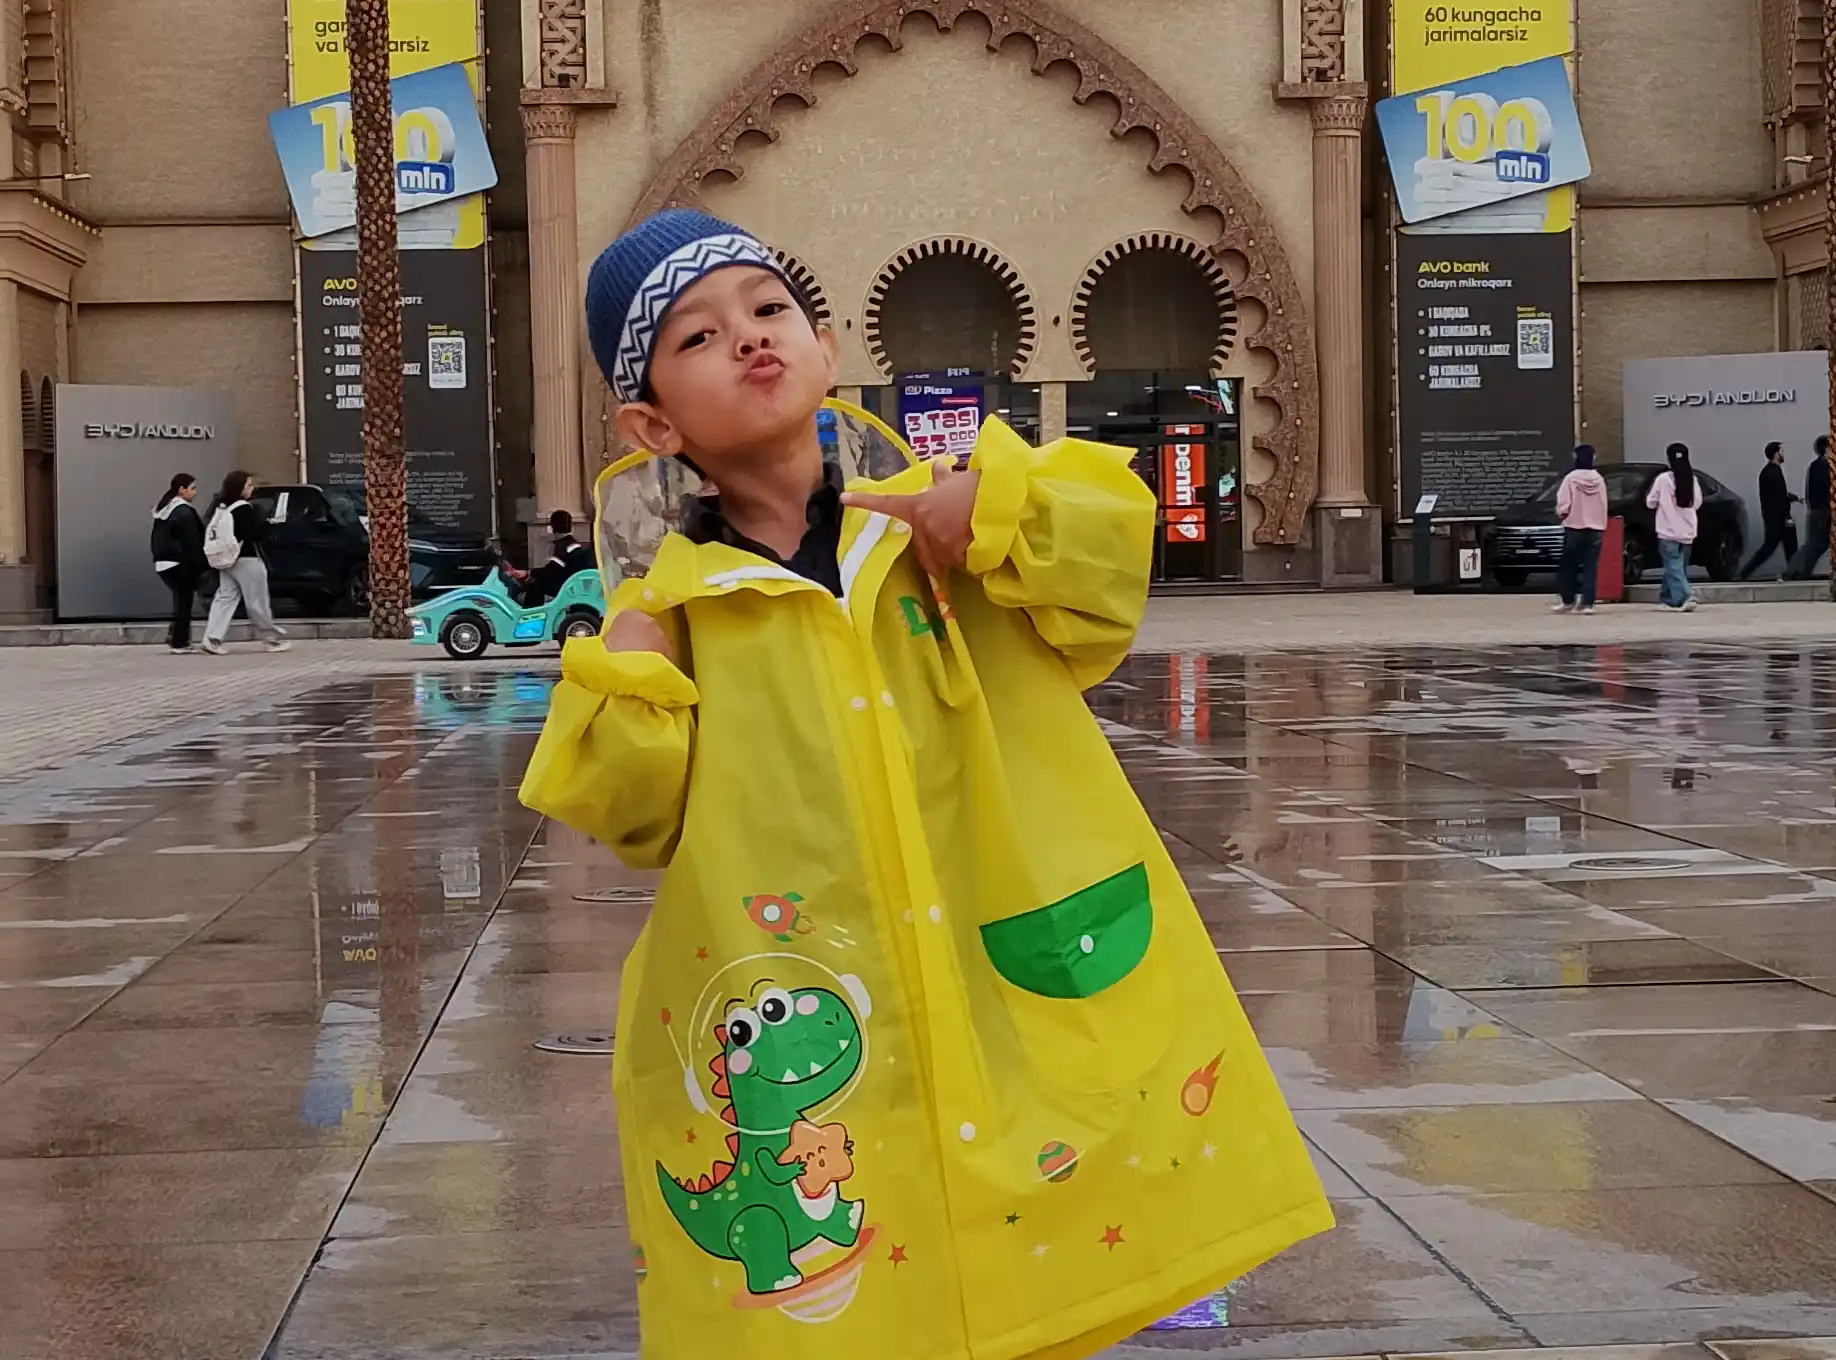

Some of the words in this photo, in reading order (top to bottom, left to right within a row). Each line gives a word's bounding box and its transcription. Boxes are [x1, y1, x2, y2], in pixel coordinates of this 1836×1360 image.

[1424, 7, 1448, 24] 60
[1451, 6, 1541, 26] kungacha
[1424, 26, 1528, 46] jarimalarsiz
[315, 41, 339, 53] va
[1416, 92, 1548, 163] 100
[309, 104, 452, 174] 10
[1418, 262, 1451, 273] AVO
[1453, 261, 1490, 273] bank
[324, 278, 357, 290] AVO
[1653, 393, 1704, 408] BYD
[86, 423, 136, 438] BYD
